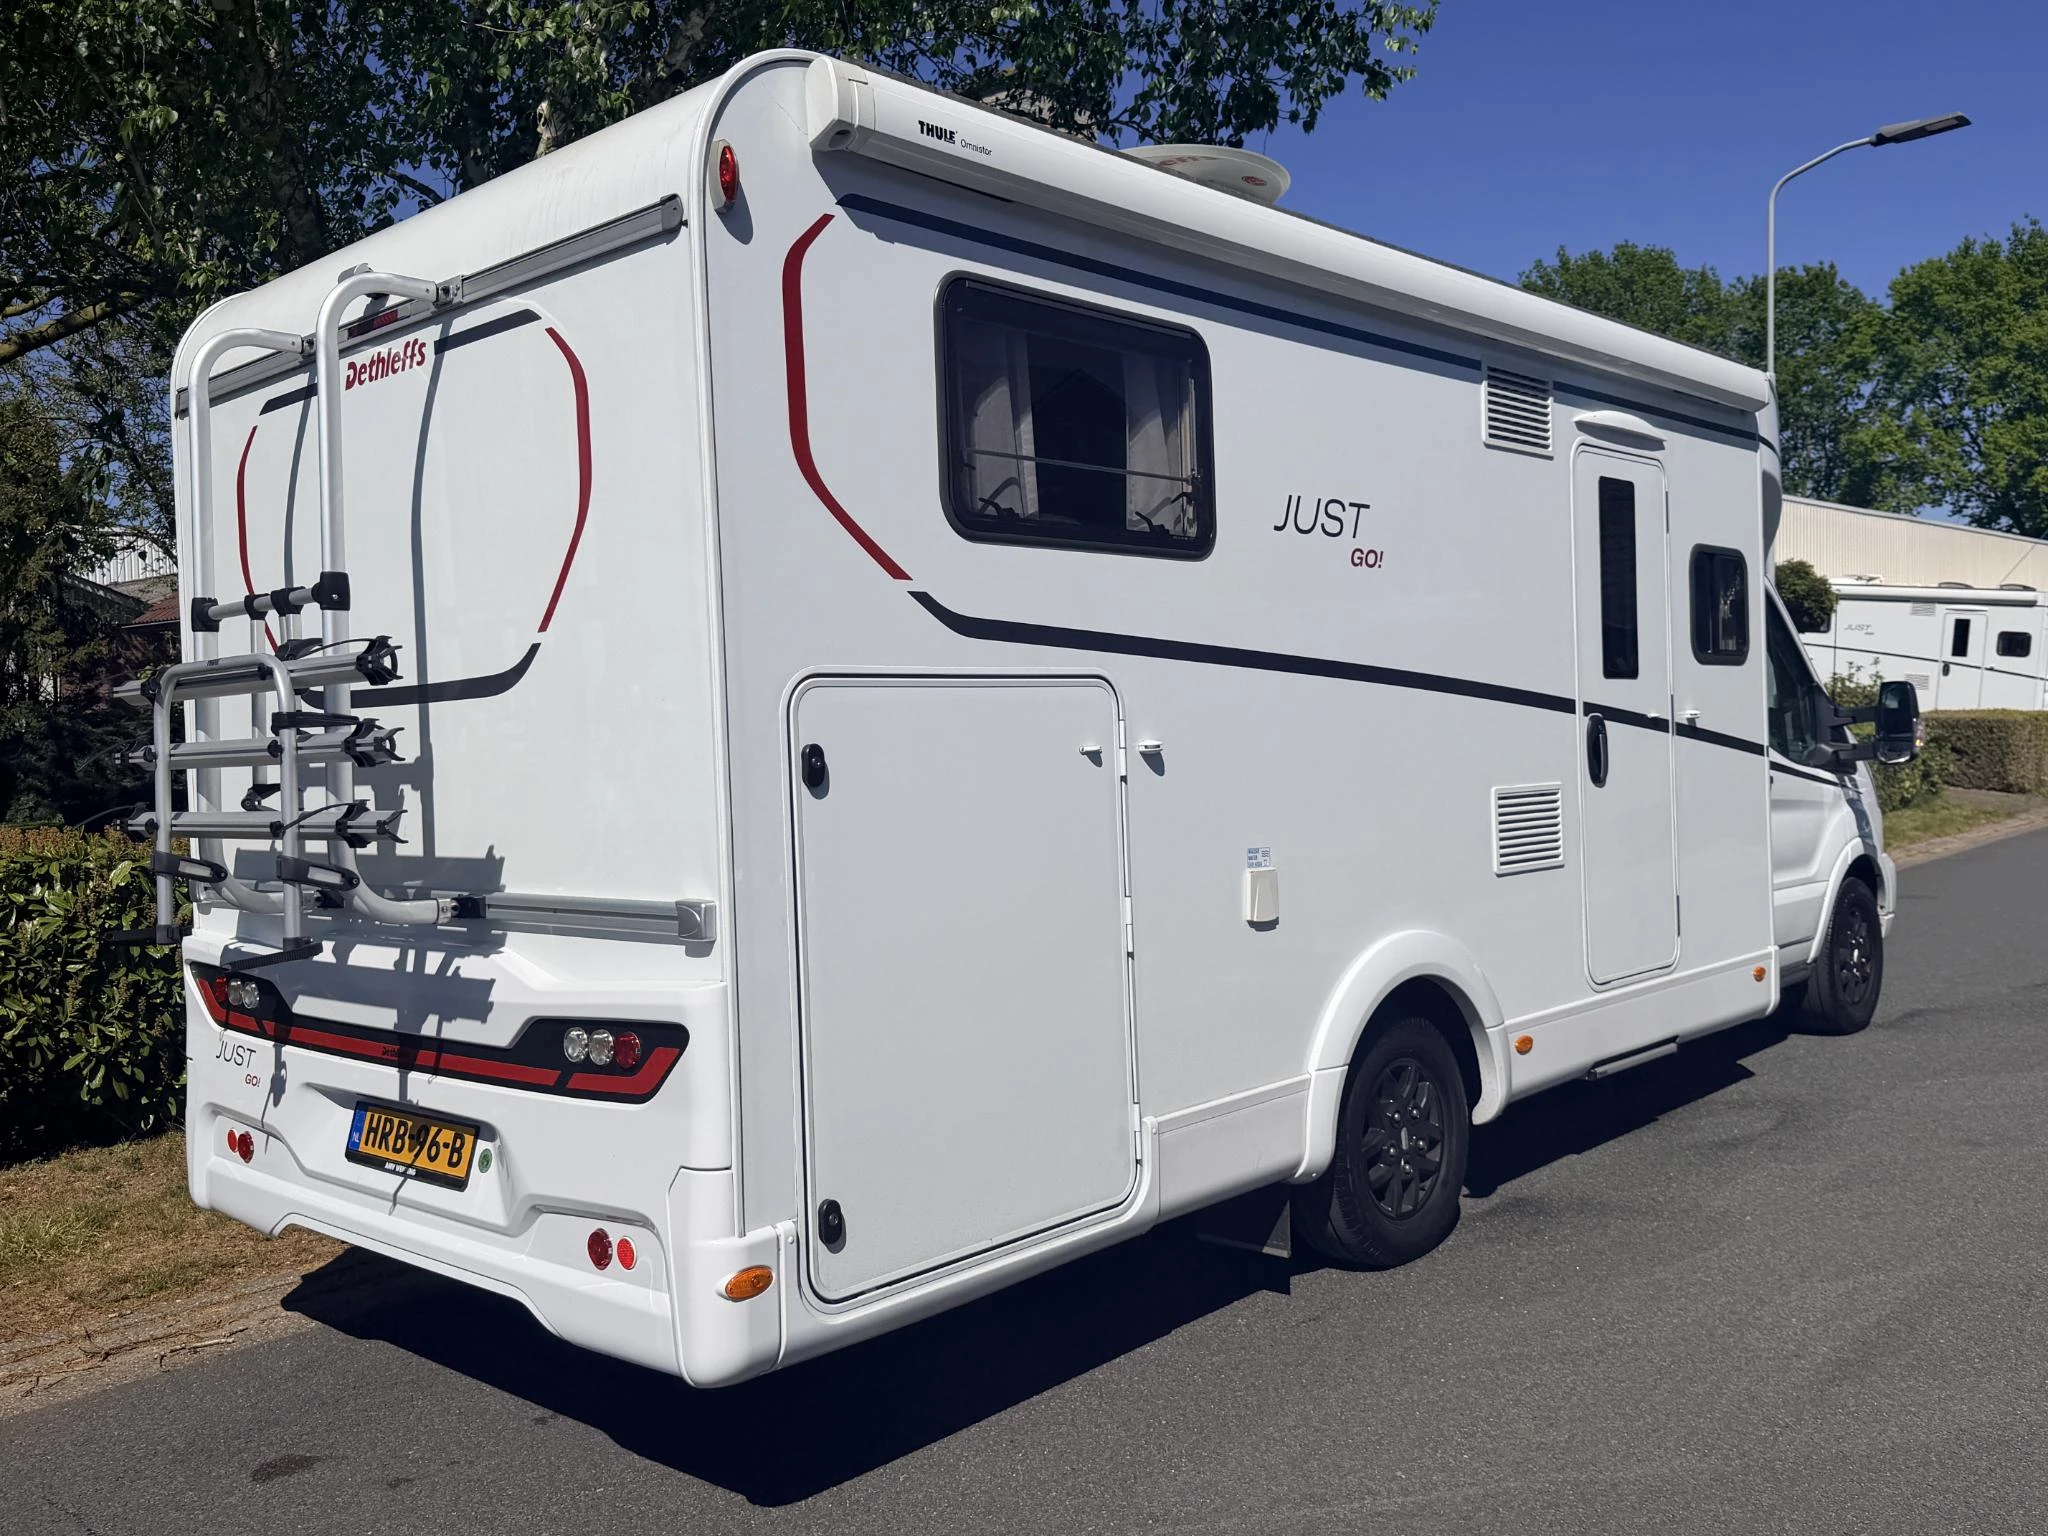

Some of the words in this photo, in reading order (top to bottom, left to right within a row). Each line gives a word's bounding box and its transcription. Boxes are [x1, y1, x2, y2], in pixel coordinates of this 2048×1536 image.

[918, 120, 956, 145] THULE
[960, 138, 992, 156] Omnistor
[345, 338, 427, 391] Dethleffs
[1273, 494, 1371, 539] JUST
[1350, 547, 1384, 569] GO!
[215, 1040, 257, 1069] JUST
[244, 1073, 261, 1088] GO!
[351, 1131, 360, 1143] NL
[364, 1113, 466, 1169] HRB-96-B
